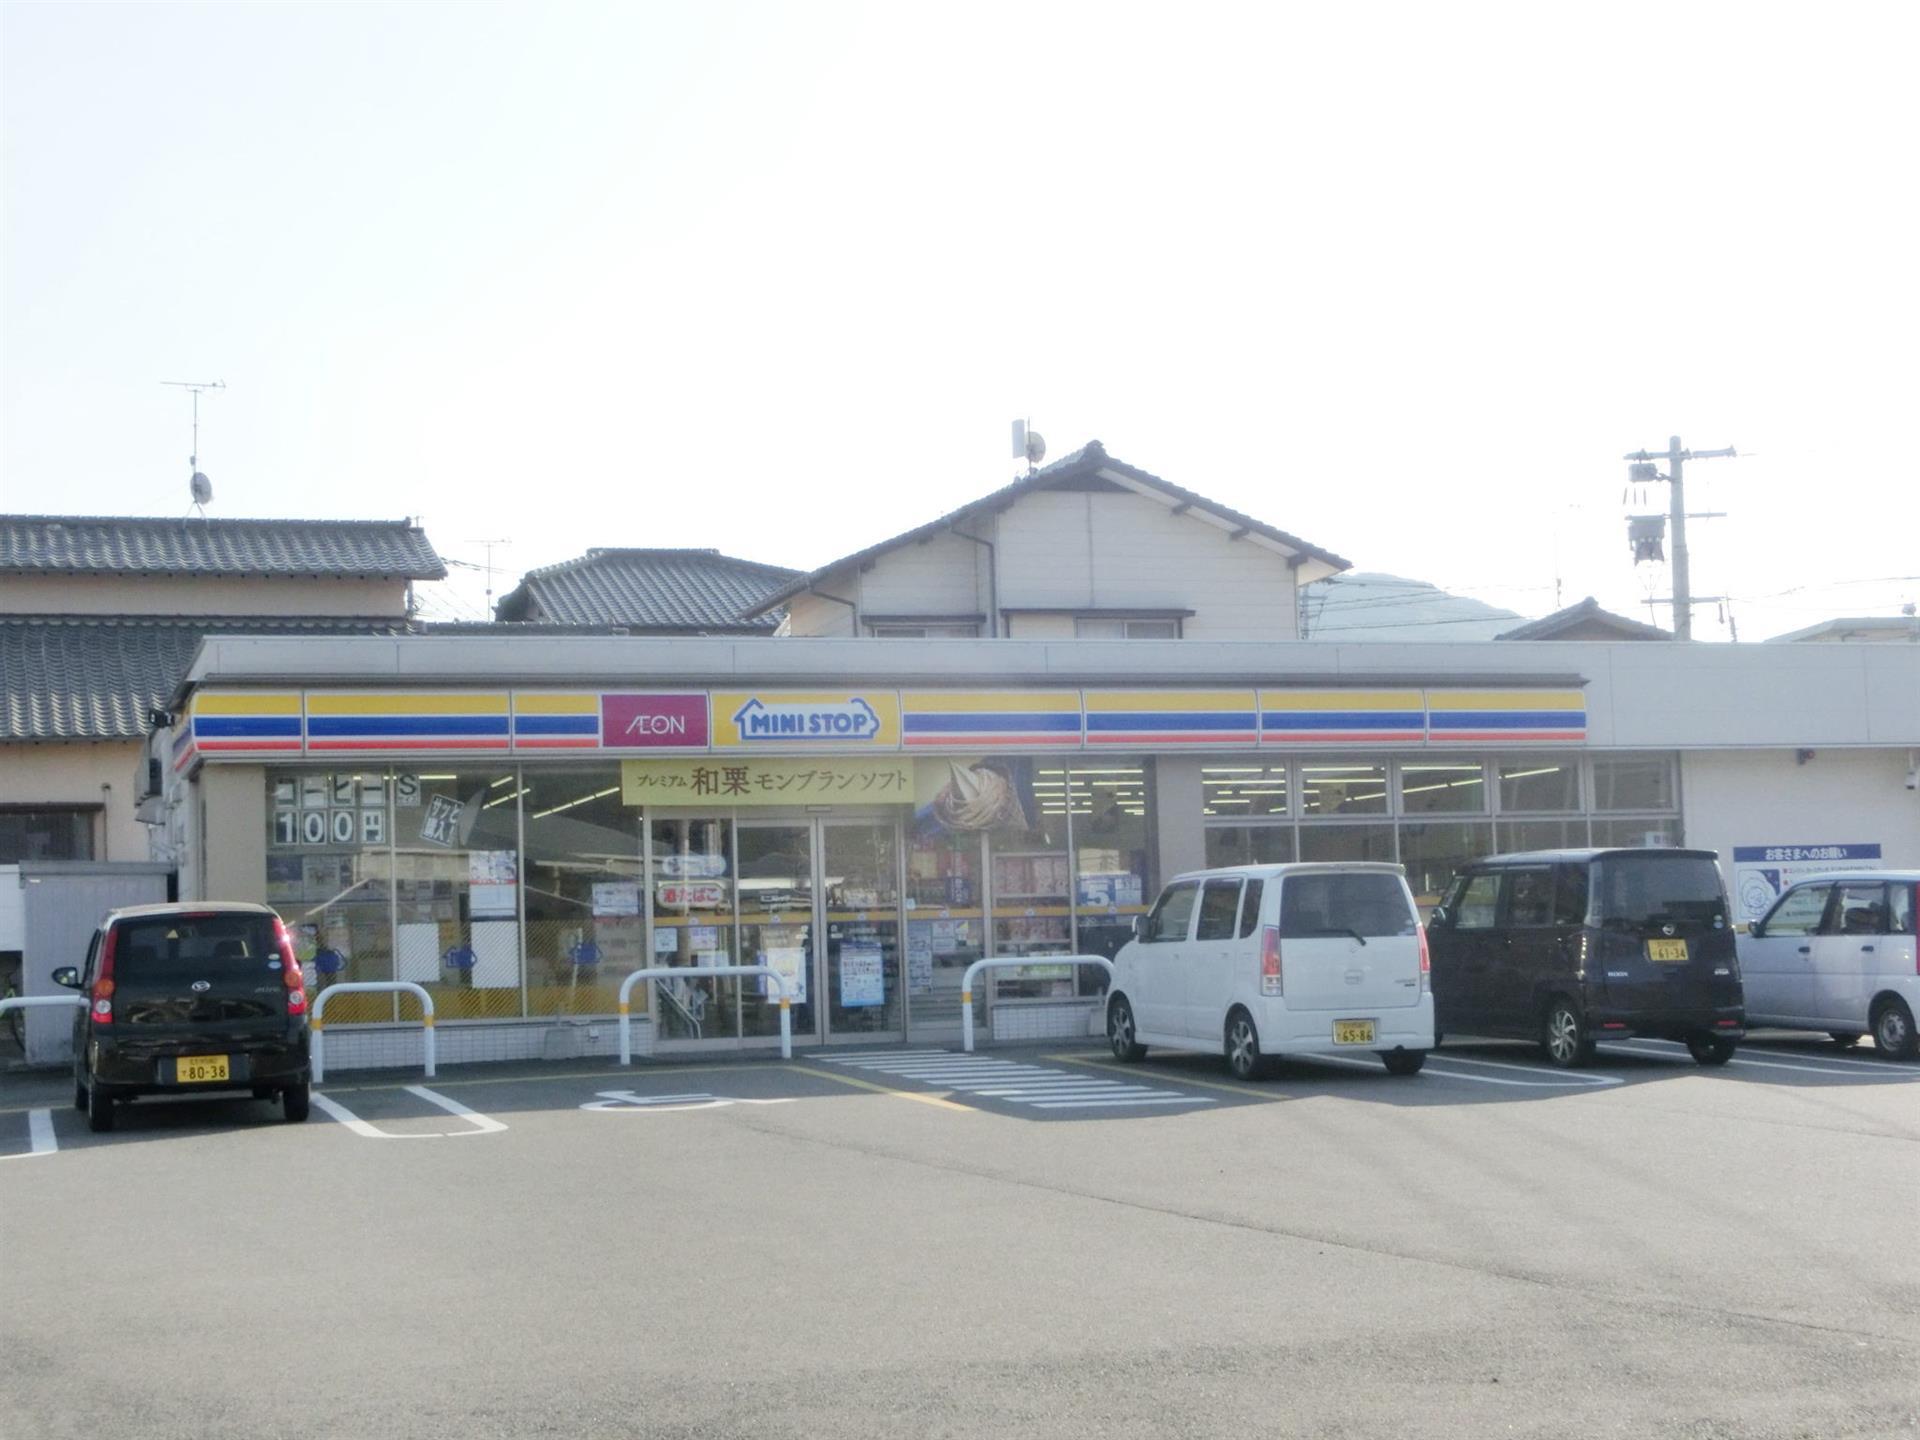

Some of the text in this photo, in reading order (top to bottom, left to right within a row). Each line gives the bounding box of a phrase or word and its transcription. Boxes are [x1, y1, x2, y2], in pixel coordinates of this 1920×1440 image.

[751, 712, 868, 734] MINI STOP
[189, 1065, 225, 1080] 80-38
